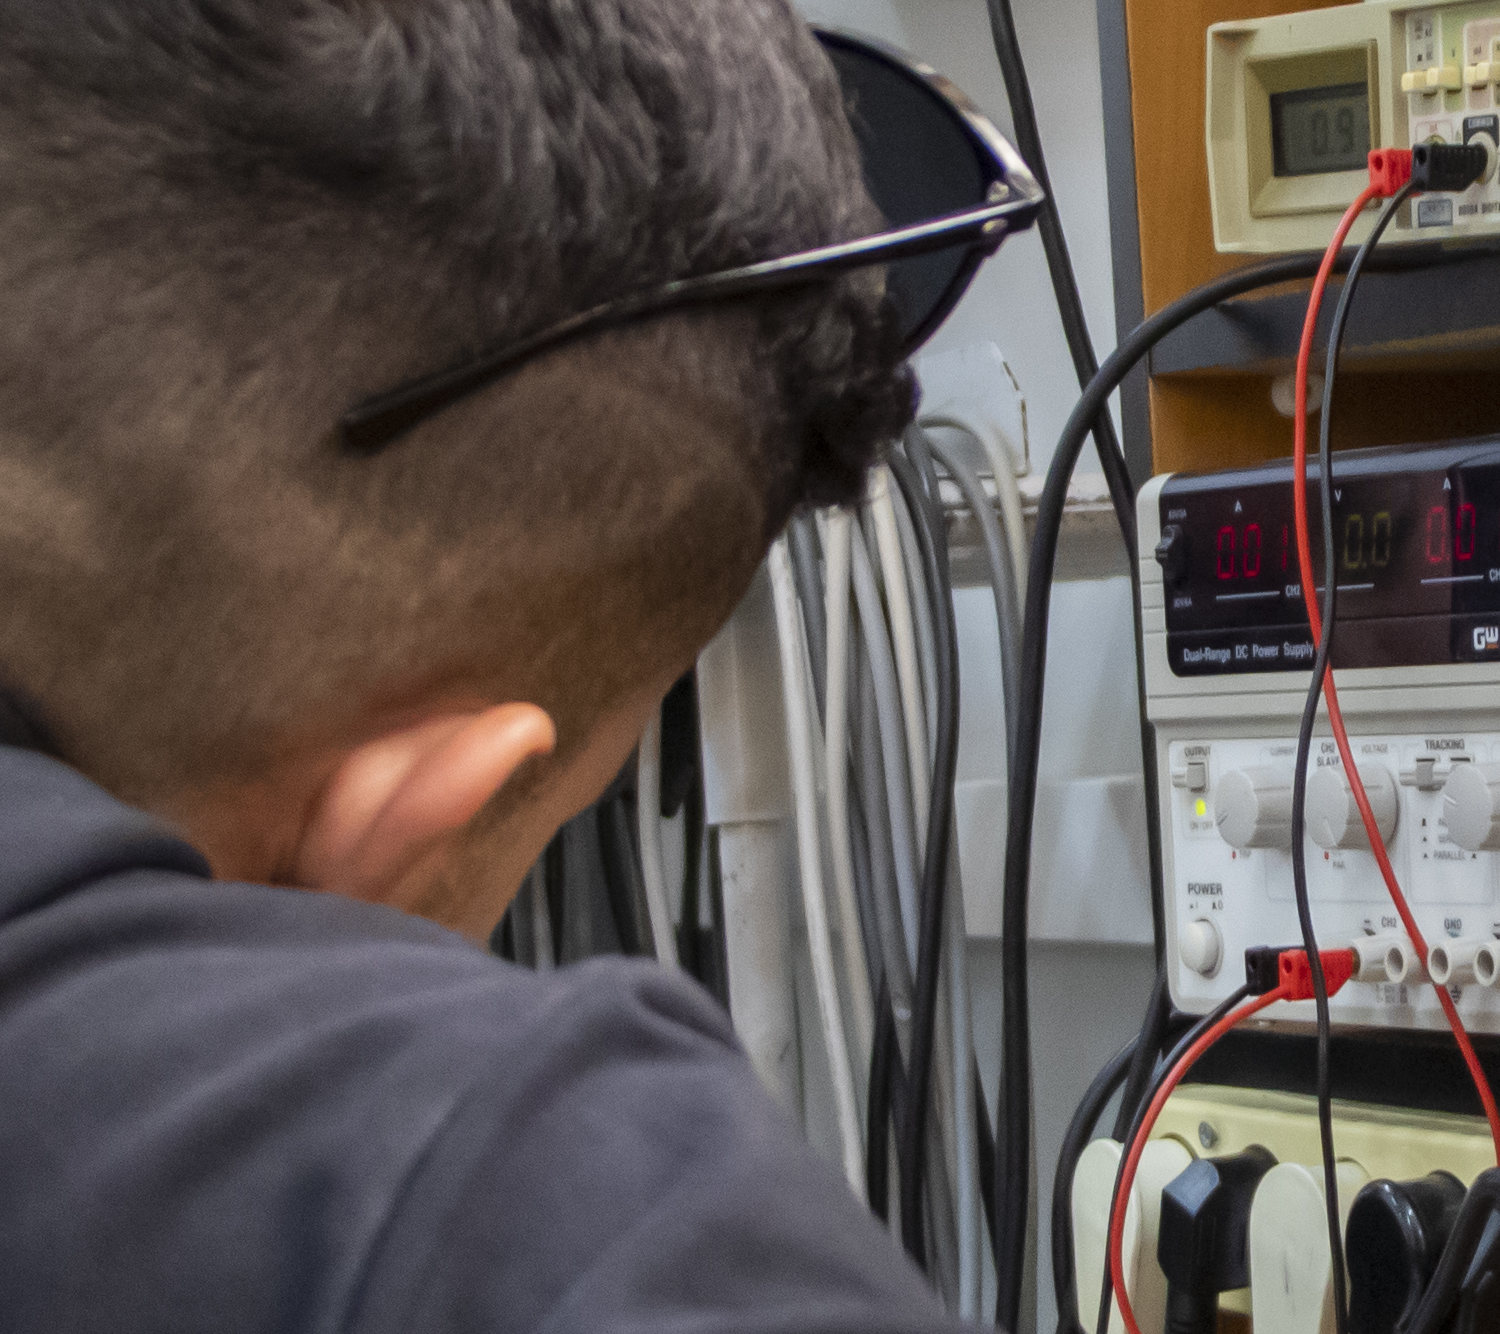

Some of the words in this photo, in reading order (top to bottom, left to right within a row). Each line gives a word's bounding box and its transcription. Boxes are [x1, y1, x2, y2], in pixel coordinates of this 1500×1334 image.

[1183, 645, 1232, 664] Dual-Range
[1235, 644, 1249, 660] DC
[1252, 642, 1280, 658] Power
[1283, 640, 1315, 658] Supply
[1424, 738, 1466, 752] TRACKING
[1187, 882, 1223, 896] POWER
[1381, 916, 1398, 929] CH2
